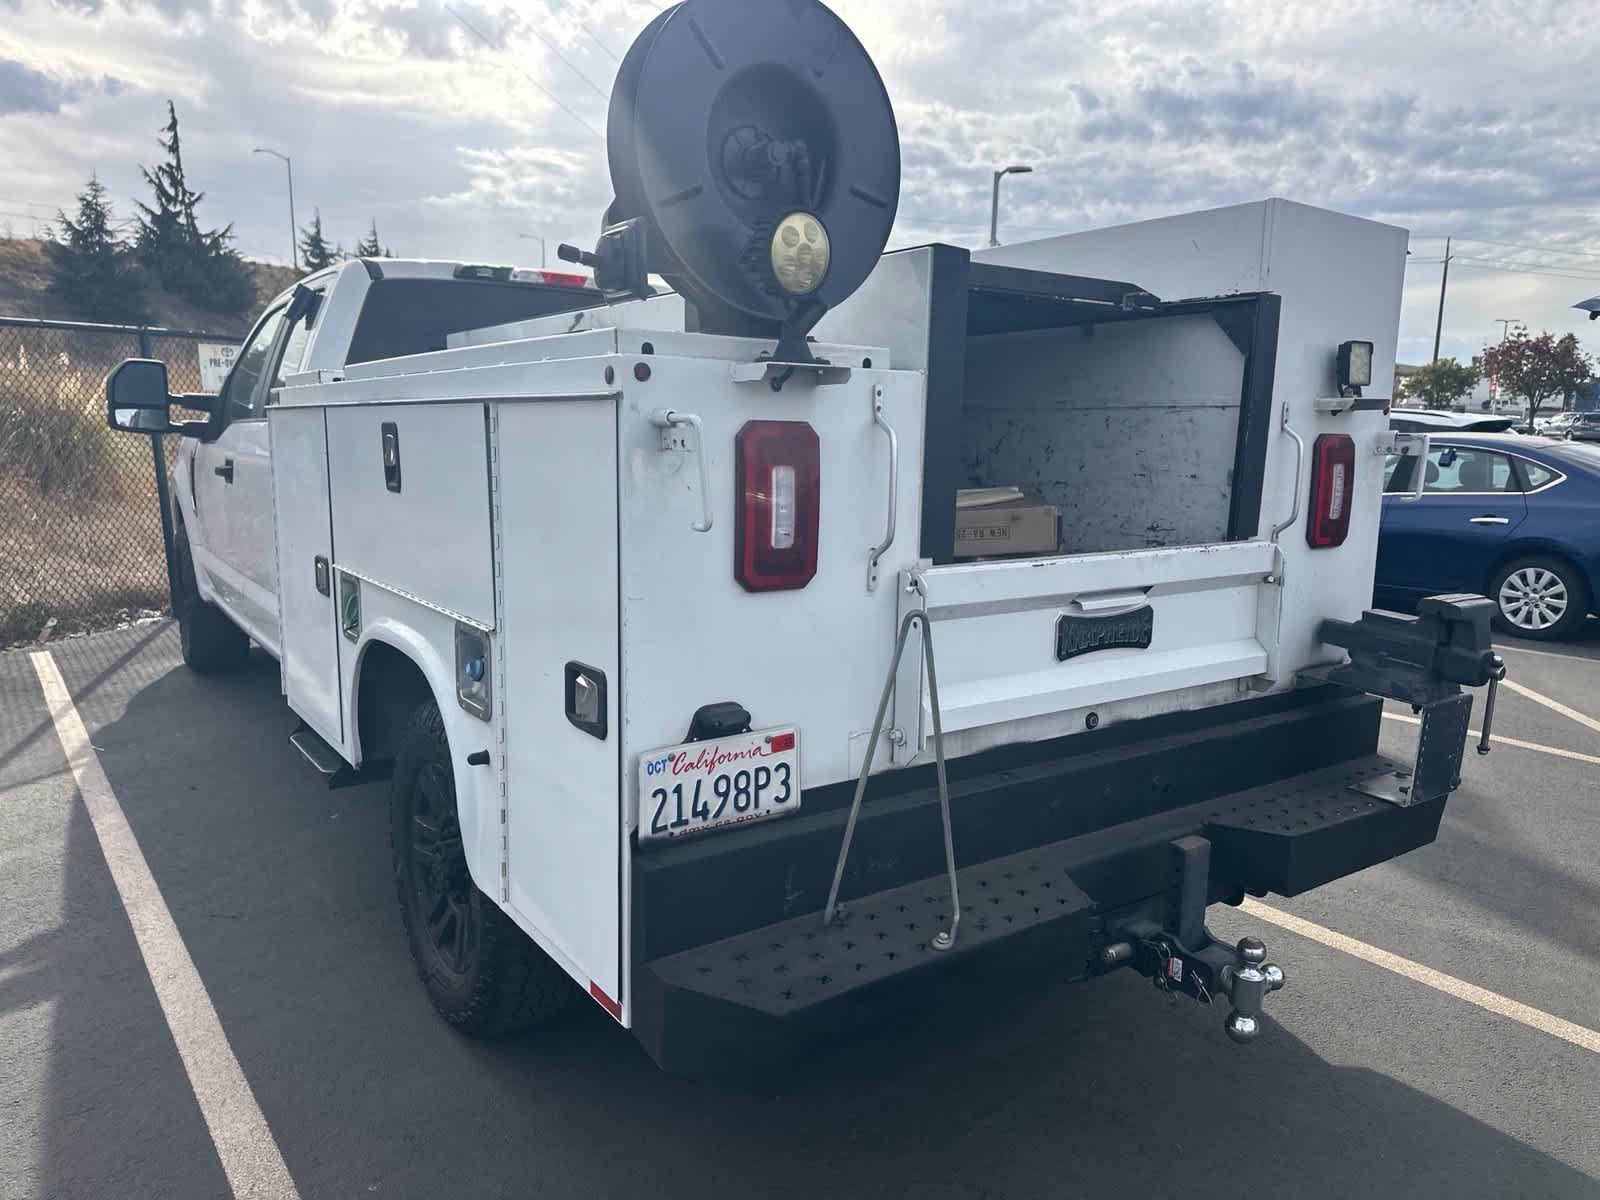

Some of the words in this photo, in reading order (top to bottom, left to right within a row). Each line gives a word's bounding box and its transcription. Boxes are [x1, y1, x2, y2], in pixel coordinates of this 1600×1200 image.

[647, 759, 668, 776] OCT
[672, 745, 771, 775] California
[651, 761, 791, 834] 21498P3
